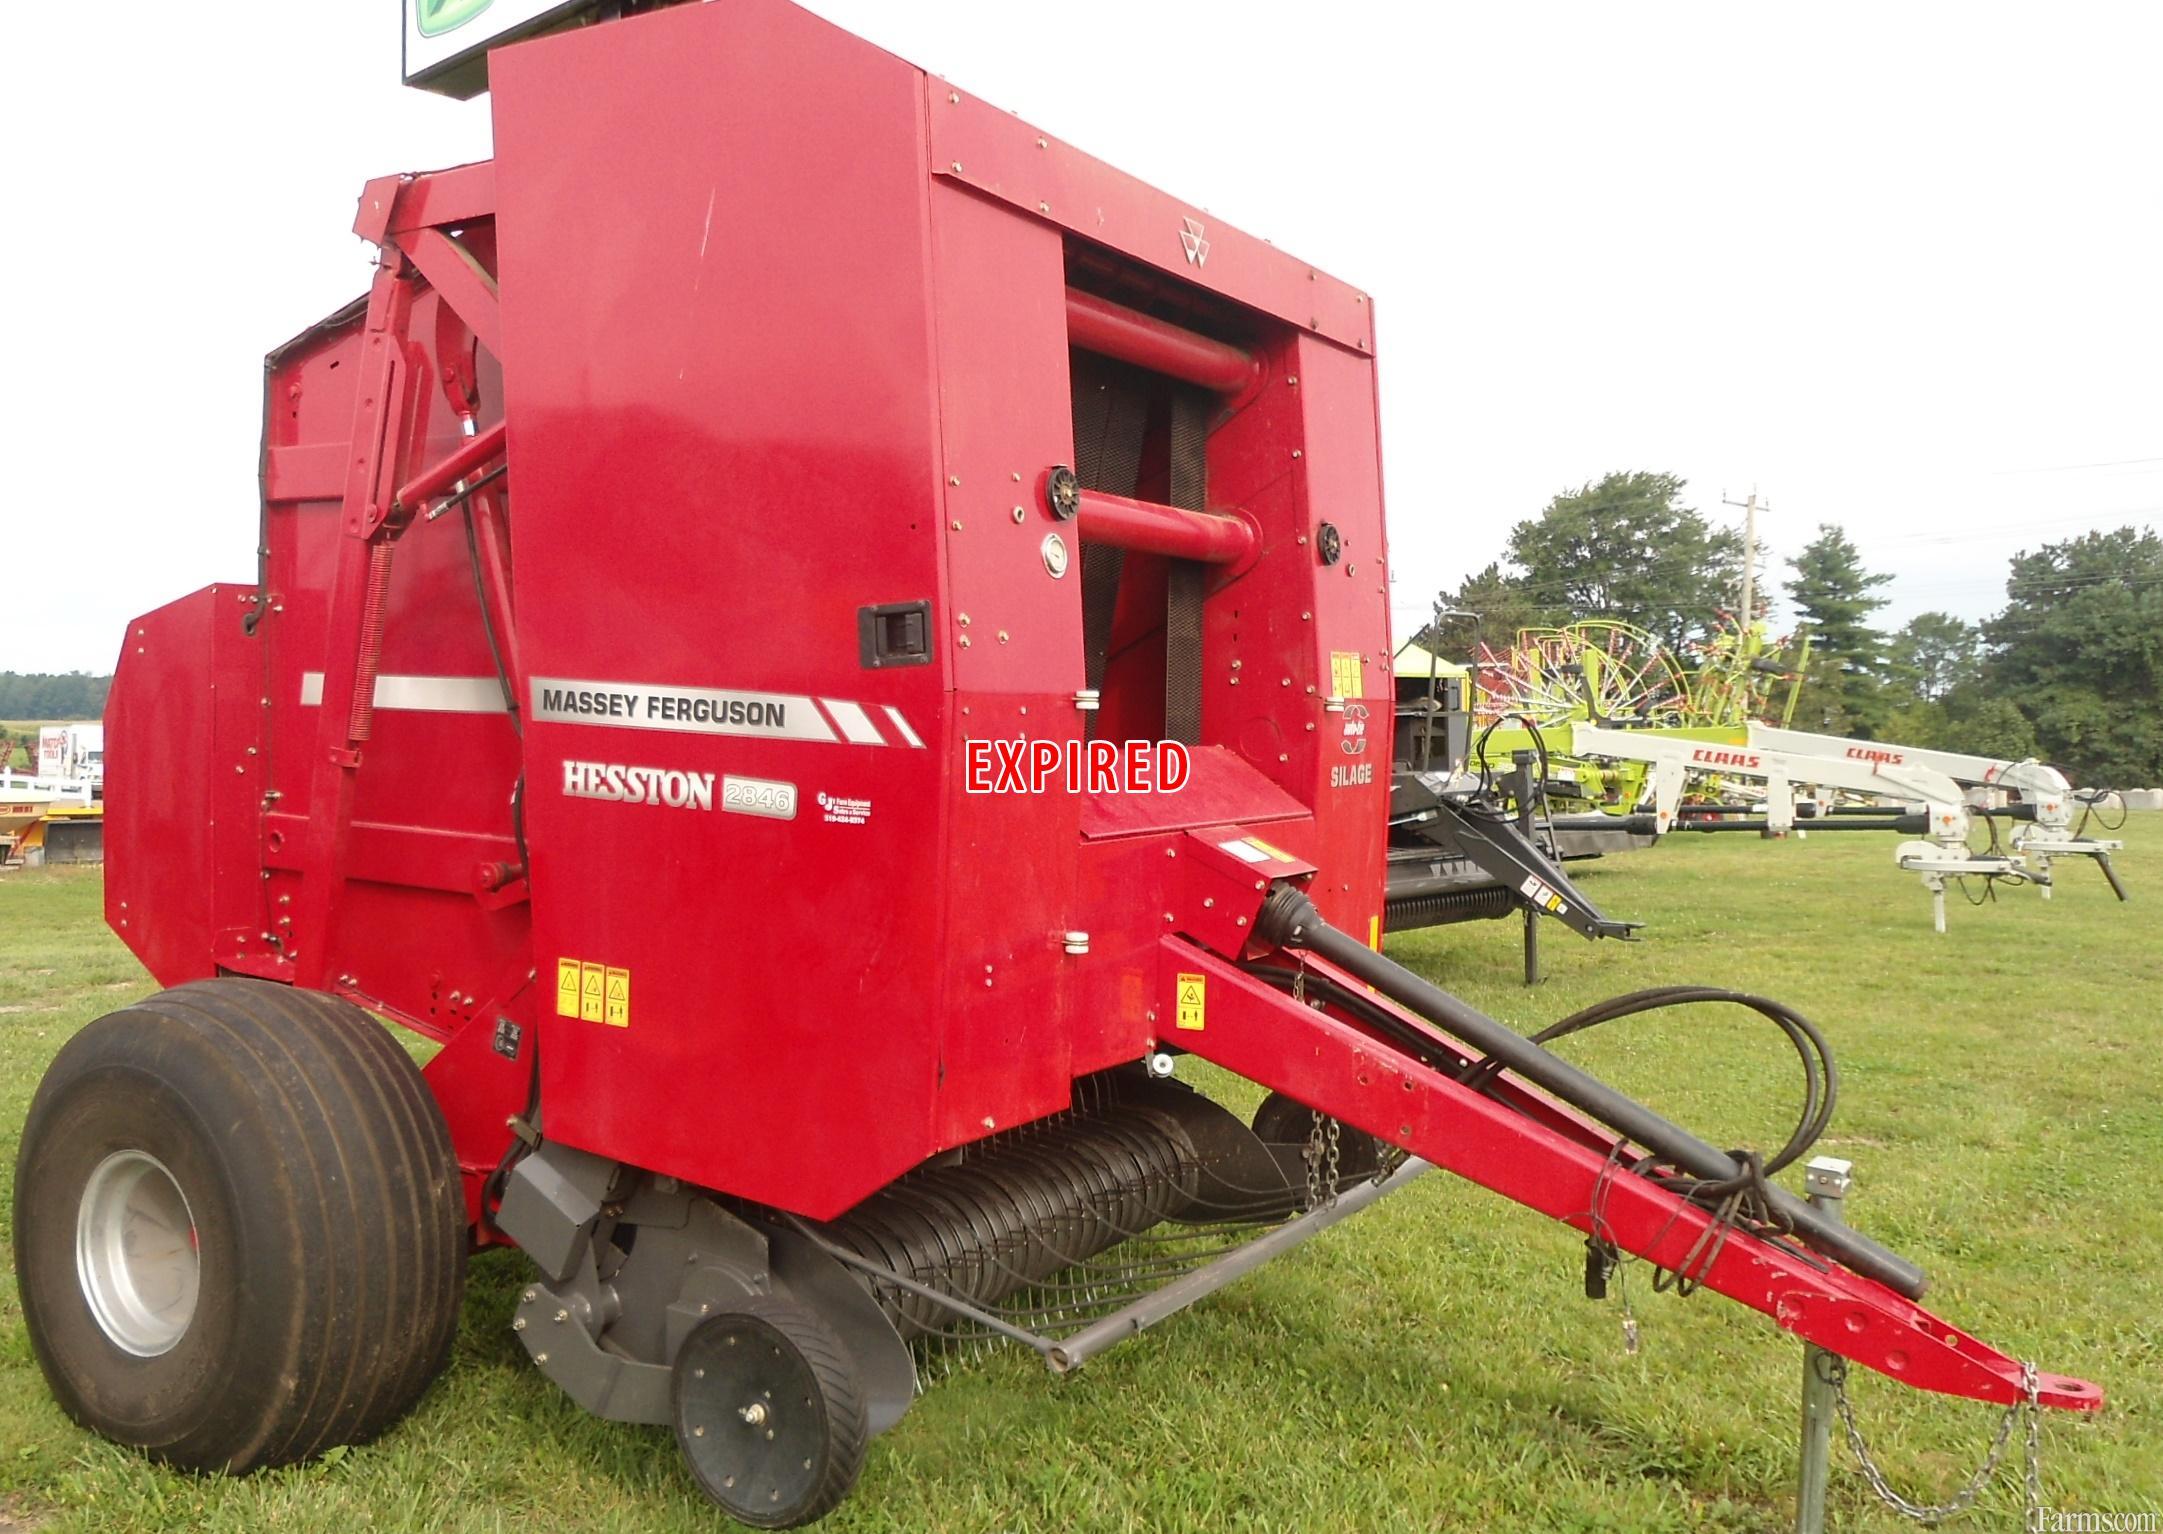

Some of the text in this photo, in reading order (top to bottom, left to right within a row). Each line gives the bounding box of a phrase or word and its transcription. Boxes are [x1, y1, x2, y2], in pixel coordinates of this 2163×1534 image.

[543, 688, 785, 728] MASSEY FERGUSON
[1692, 749, 1760, 768] CLAAS
[1846, 748, 1904, 765] CLAAS
[563, 760, 715, 811] HESSTON
[1330, 763, 1373, 788] SILAGE
[726, 783, 791, 812] 2846
